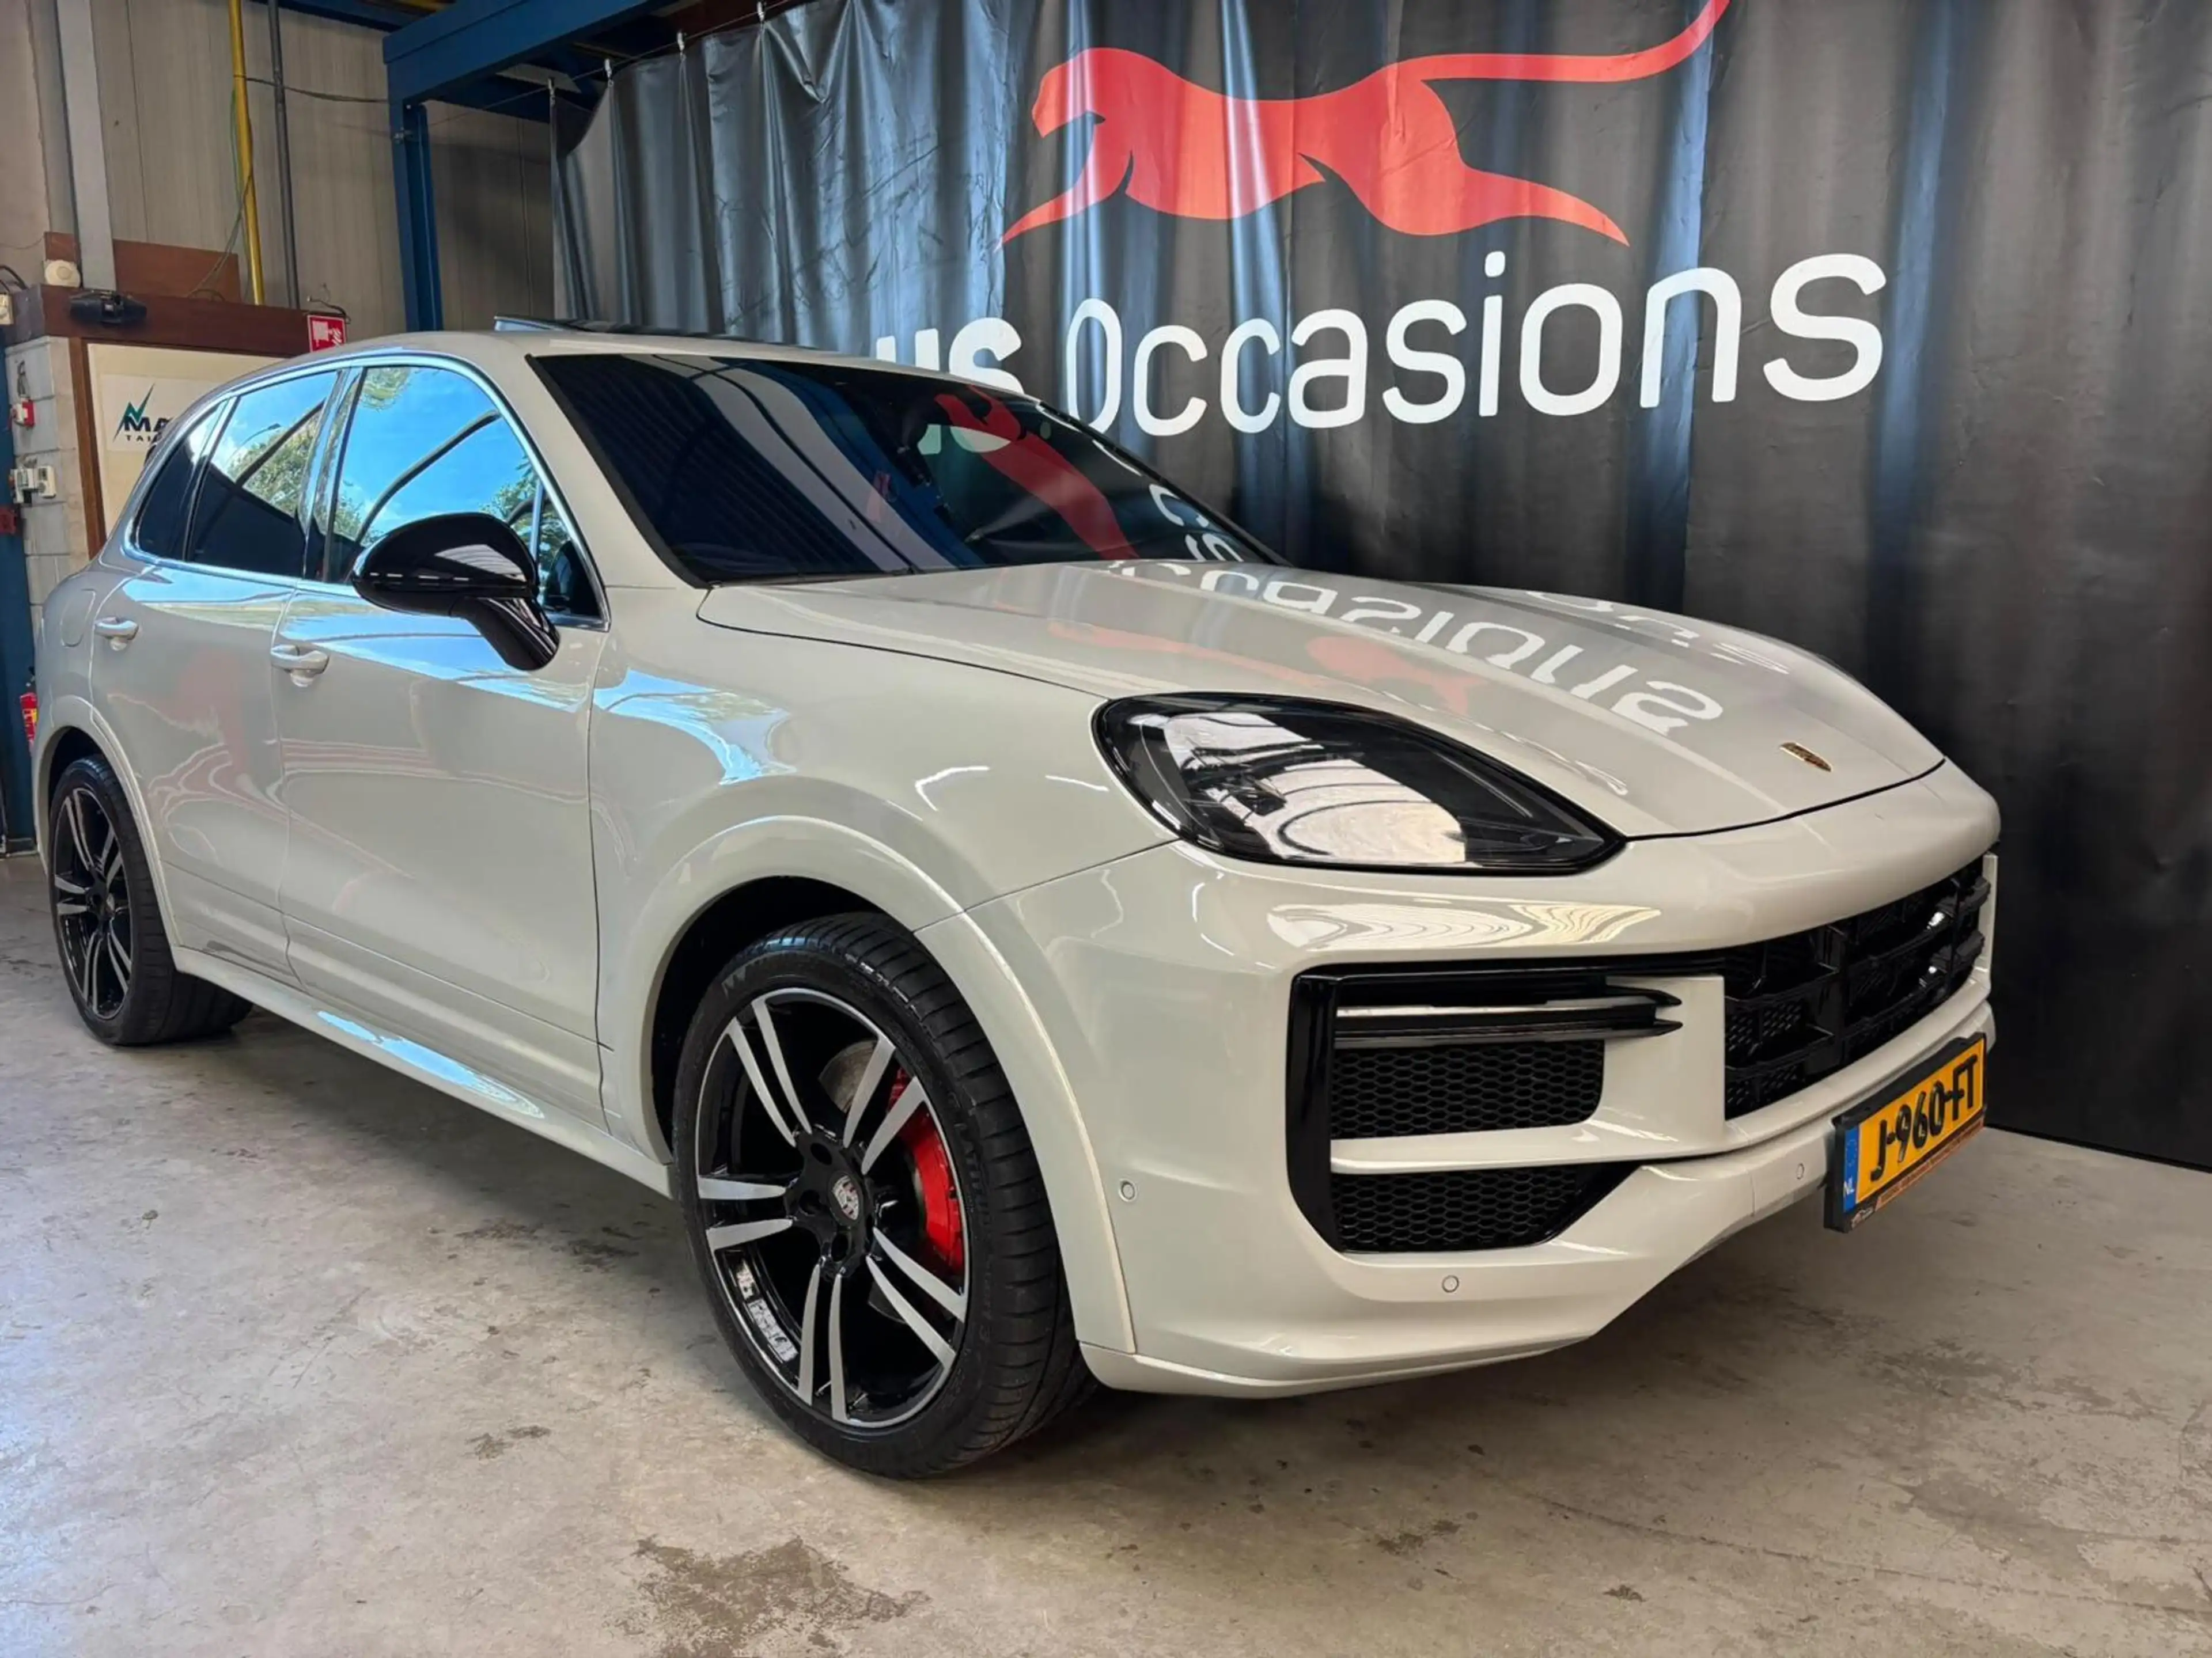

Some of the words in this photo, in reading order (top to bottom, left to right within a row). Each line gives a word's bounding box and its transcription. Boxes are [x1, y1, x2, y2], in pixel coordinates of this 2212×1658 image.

[1066, 251, 1887, 437] Occasions
[1870, 1054, 1978, 1182] J-960-FT
[1843, 1177, 1855, 1198] NL
